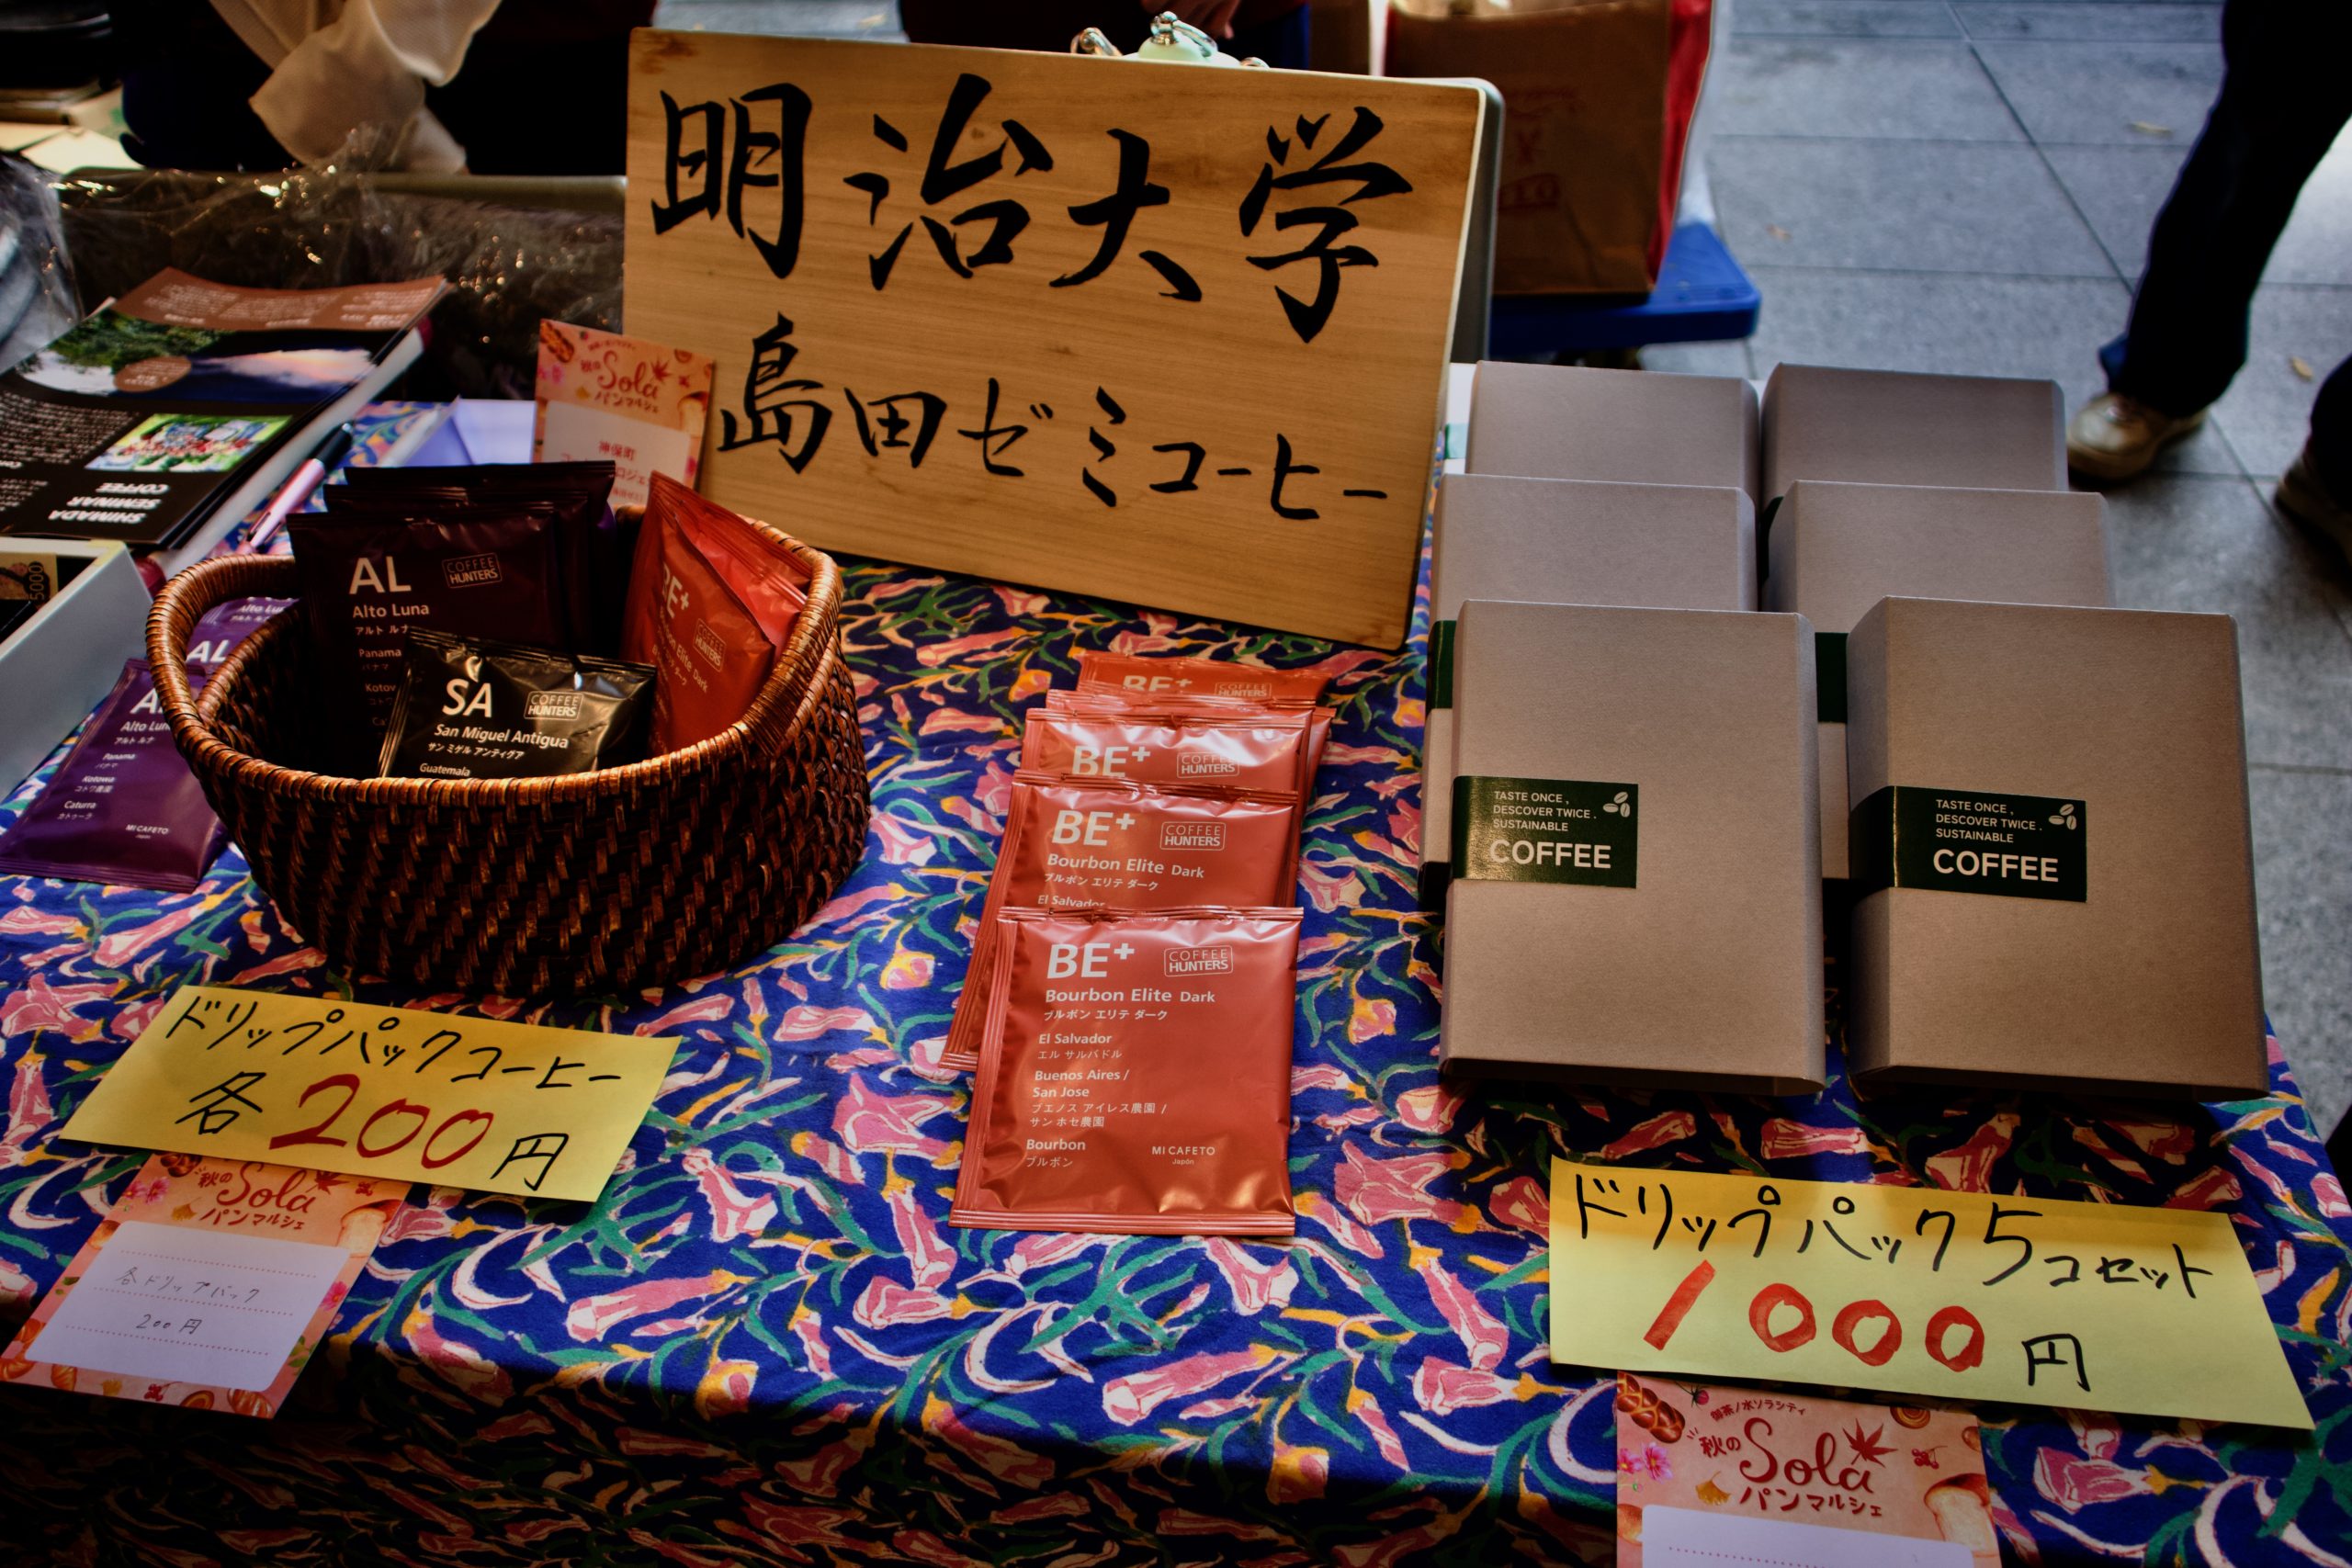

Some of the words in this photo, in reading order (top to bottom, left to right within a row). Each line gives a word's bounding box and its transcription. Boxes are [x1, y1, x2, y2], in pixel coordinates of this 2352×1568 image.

[650, 73, 1412, 343] 明治大学
[598, 350, 659, 399] Sola
[718, 311, 1387, 519] 島田ゼミコーヒー
[96, 482, 171, 495] COFFEE
[447, 557, 495, 573] COFFEE
[349, 556, 412, 594] AL
[449, 568, 499, 584] HUNTERS
[353, 604, 387, 618] Alto
[392, 604, 430, 617] Luna
[186, 639, 230, 663] AL
[359, 649, 402, 659] Panama
[695, 636, 722, 667] HUNTERS
[676, 645, 692, 672] Elite
[693, 666, 708, 693] Dark
[442, 679, 492, 717] SA
[530, 694, 579, 707] COFFEE
[1218, 689, 1267, 697] HUNTERS
[130, 688, 163, 714] A
[527, 705, 577, 716] HUNTERS
[120, 721, 147, 732] Alto
[435, 724, 459, 738] San
[461, 726, 508, 743] Miguel
[511, 730, 569, 750] Antigua
[1071, 746, 1151, 777] BE+
[1181, 763, 1236, 775] HUNTERS
[419, 762, 470, 777] Guatemala
[1494, 791, 1528, 802] TASTE
[1493, 806, 1554, 817] DESCOVER
[1935, 799, 1972, 811] TASTE
[1051, 810, 1136, 847] BE+
[1493, 818, 1568, 832] SUSTAINABLE
[1935, 814, 1997, 828] DESCOVER
[1166, 825, 1221, 836] COFFEE
[1935, 828, 2015, 843] SUSTAINABLE
[1164, 836, 1221, 847] HUNTERS
[1489, 839, 1611, 869] COFFEE
[1047, 852, 1121, 871] Bourbon
[1126, 859, 1165, 874] Elite
[1171, 864, 1205, 878] Dark
[1933, 848, 2059, 883] COFFEE
[1037, 895, 1049, 905] El
[1046, 942, 1135, 979] BE+
[1169, 949, 1228, 962] COFFEE
[1169, 959, 1229, 973] HUNTERS
[1046, 987, 1125, 1003] Bourbon
[1131, 987, 1172, 1002] Elite
[1180, 991, 1216, 1003] Dark
[165, 995, 622, 1090] ドリップパックコーヒー
[1038, 1033, 1050, 1044] El
[1055, 1032, 1113, 1044] Salvador
[1035, 1070, 1083, 1081] Buenos
[1086, 1069, 1121, 1081] Aires
[1033, 1087, 1057, 1098] San
[1060, 1087, 1090, 1098] Jose
[1026, 1139, 1086, 1151] Bourbon
[1152, 1146, 1166, 1155] MI
[1168, 1145, 1216, 1156] CAFETO
[1025, 1156, 1073, 1168] ブルボン
[198, 1169, 232, 1189] 秋の
[217, 1161, 317, 1213] Sola
[200, 1207, 305, 1230] パンマルシェ
[1710, 1399, 1806, 1422] 御茶ノ水ソラシティ
[1699, 1434, 1741, 1459] 秋の
[1738, 1416, 1874, 1495] Sola
[1738, 1487, 1883, 1517] パンマルシェ
